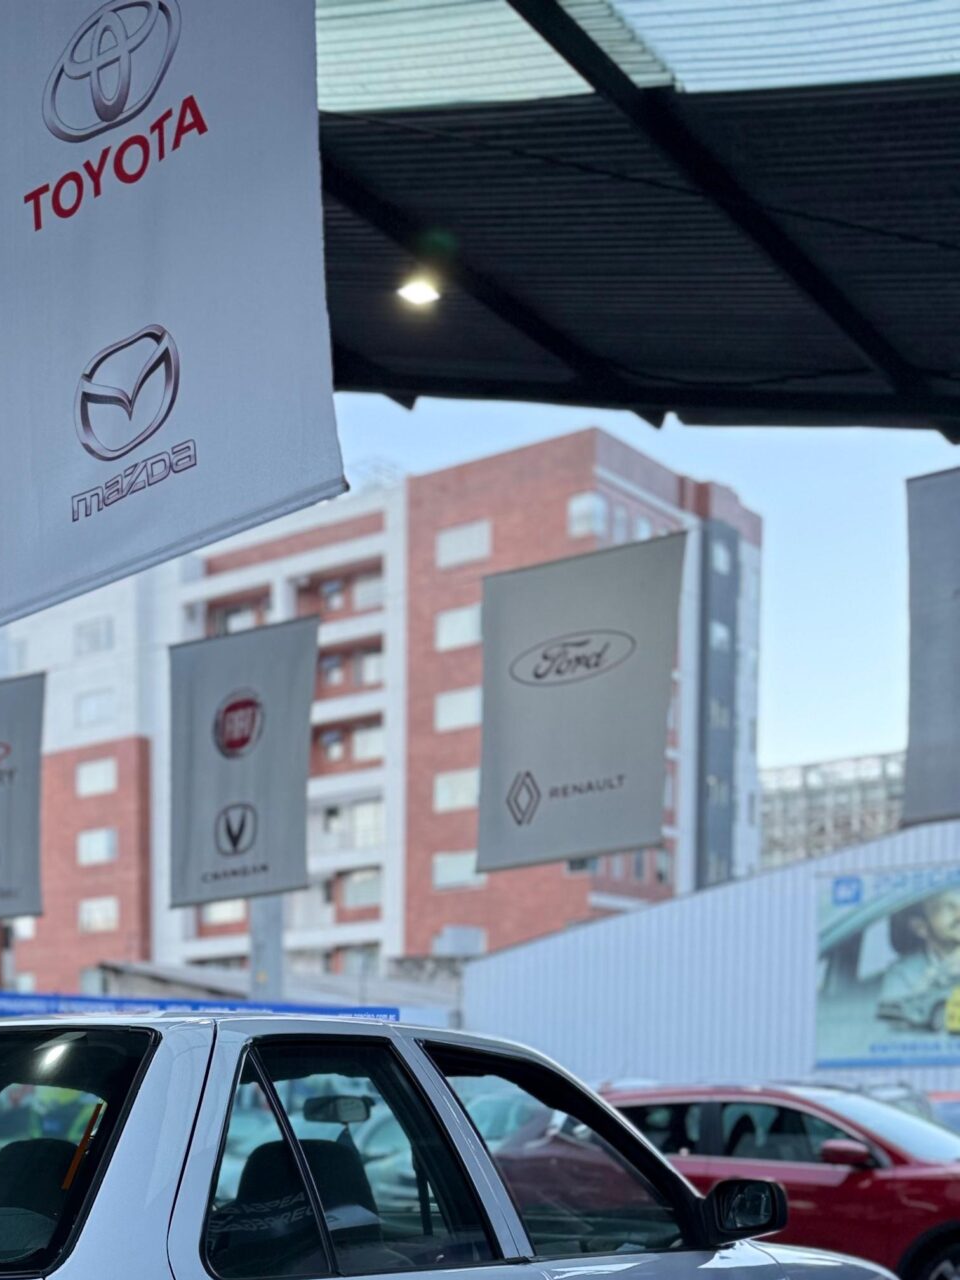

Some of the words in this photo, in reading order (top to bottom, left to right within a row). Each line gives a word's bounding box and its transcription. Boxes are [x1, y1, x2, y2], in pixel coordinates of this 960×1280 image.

[24, 95, 208, 231] TOYOTA
[71, 438, 197, 523] mazda
[533, 638, 610, 679] Ford
[549, 774, 626, 798] RENAULT
